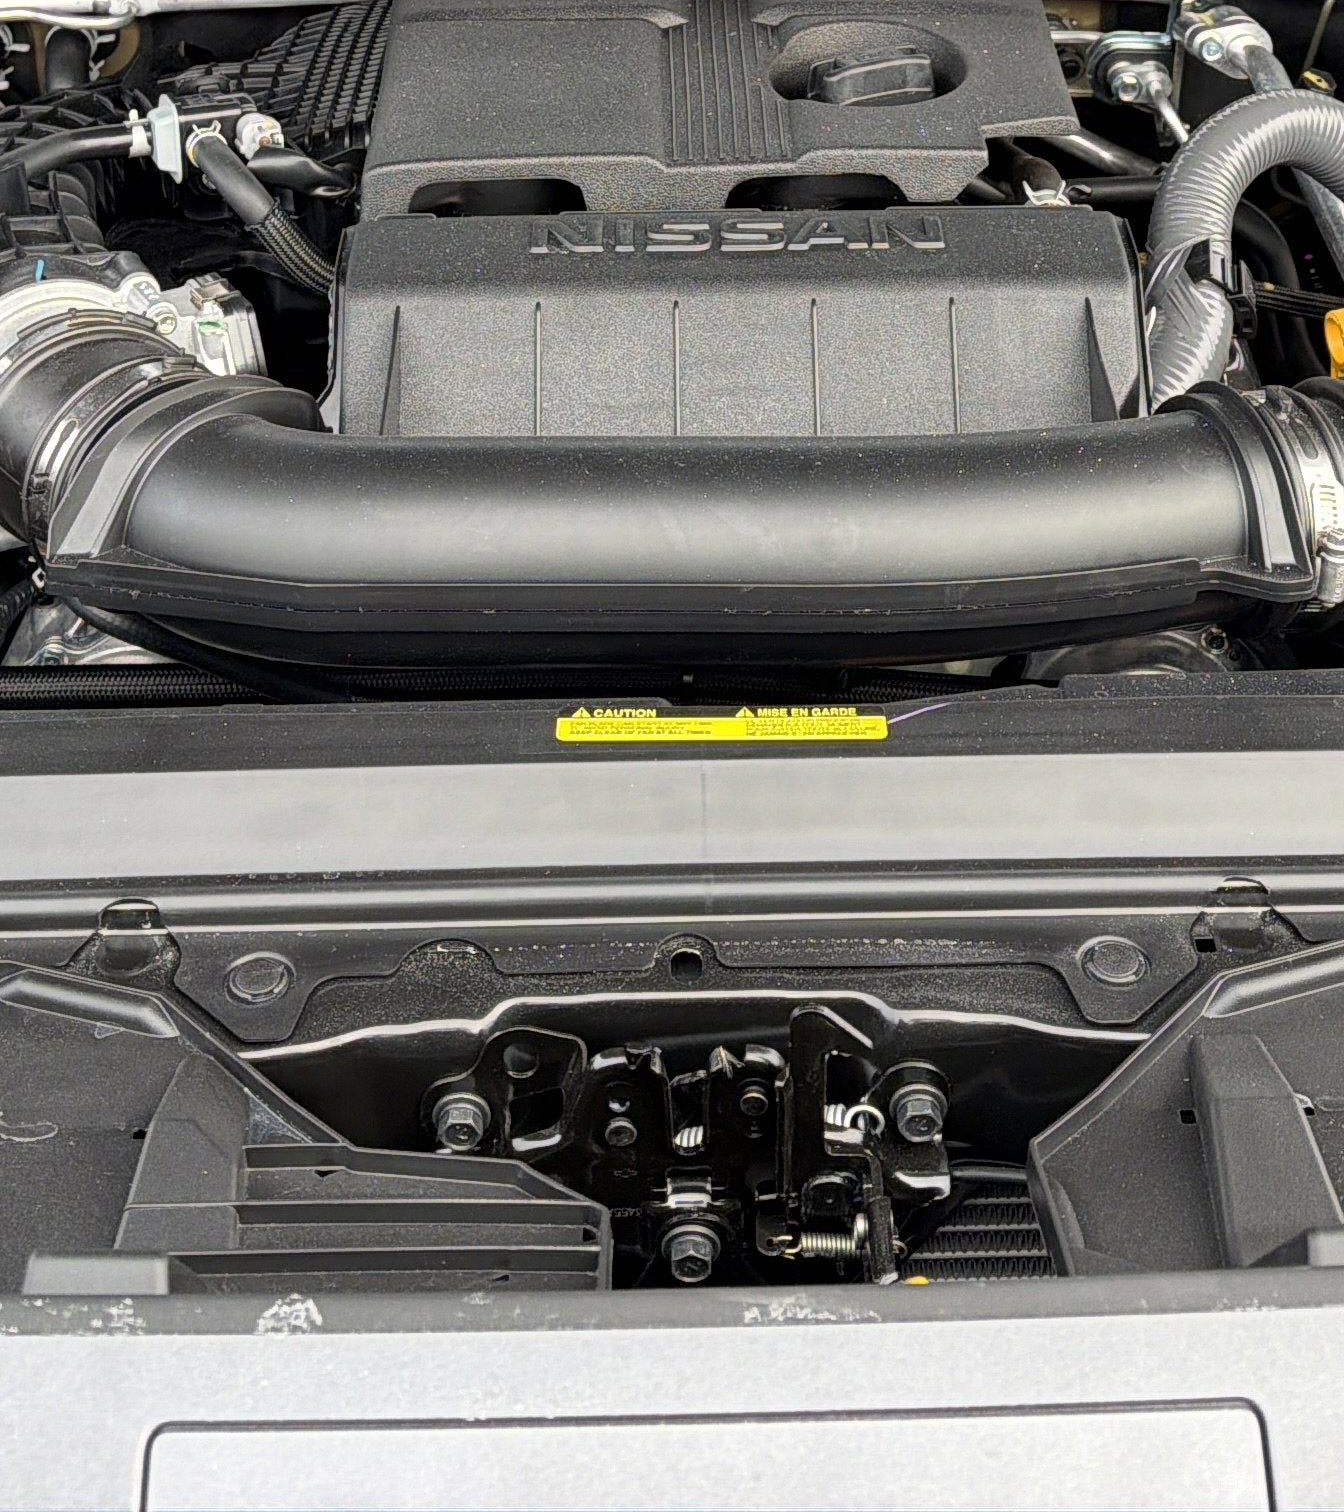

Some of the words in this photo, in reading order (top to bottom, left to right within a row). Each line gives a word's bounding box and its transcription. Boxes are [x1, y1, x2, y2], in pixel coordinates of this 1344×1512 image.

[529, 215, 946, 254] NISSAN
[593, 708, 657, 718] CAUTION
[757, 708, 788, 718] MISE
[791, 708, 809, 718] EN
[811, 707, 857, 717] GARDE
